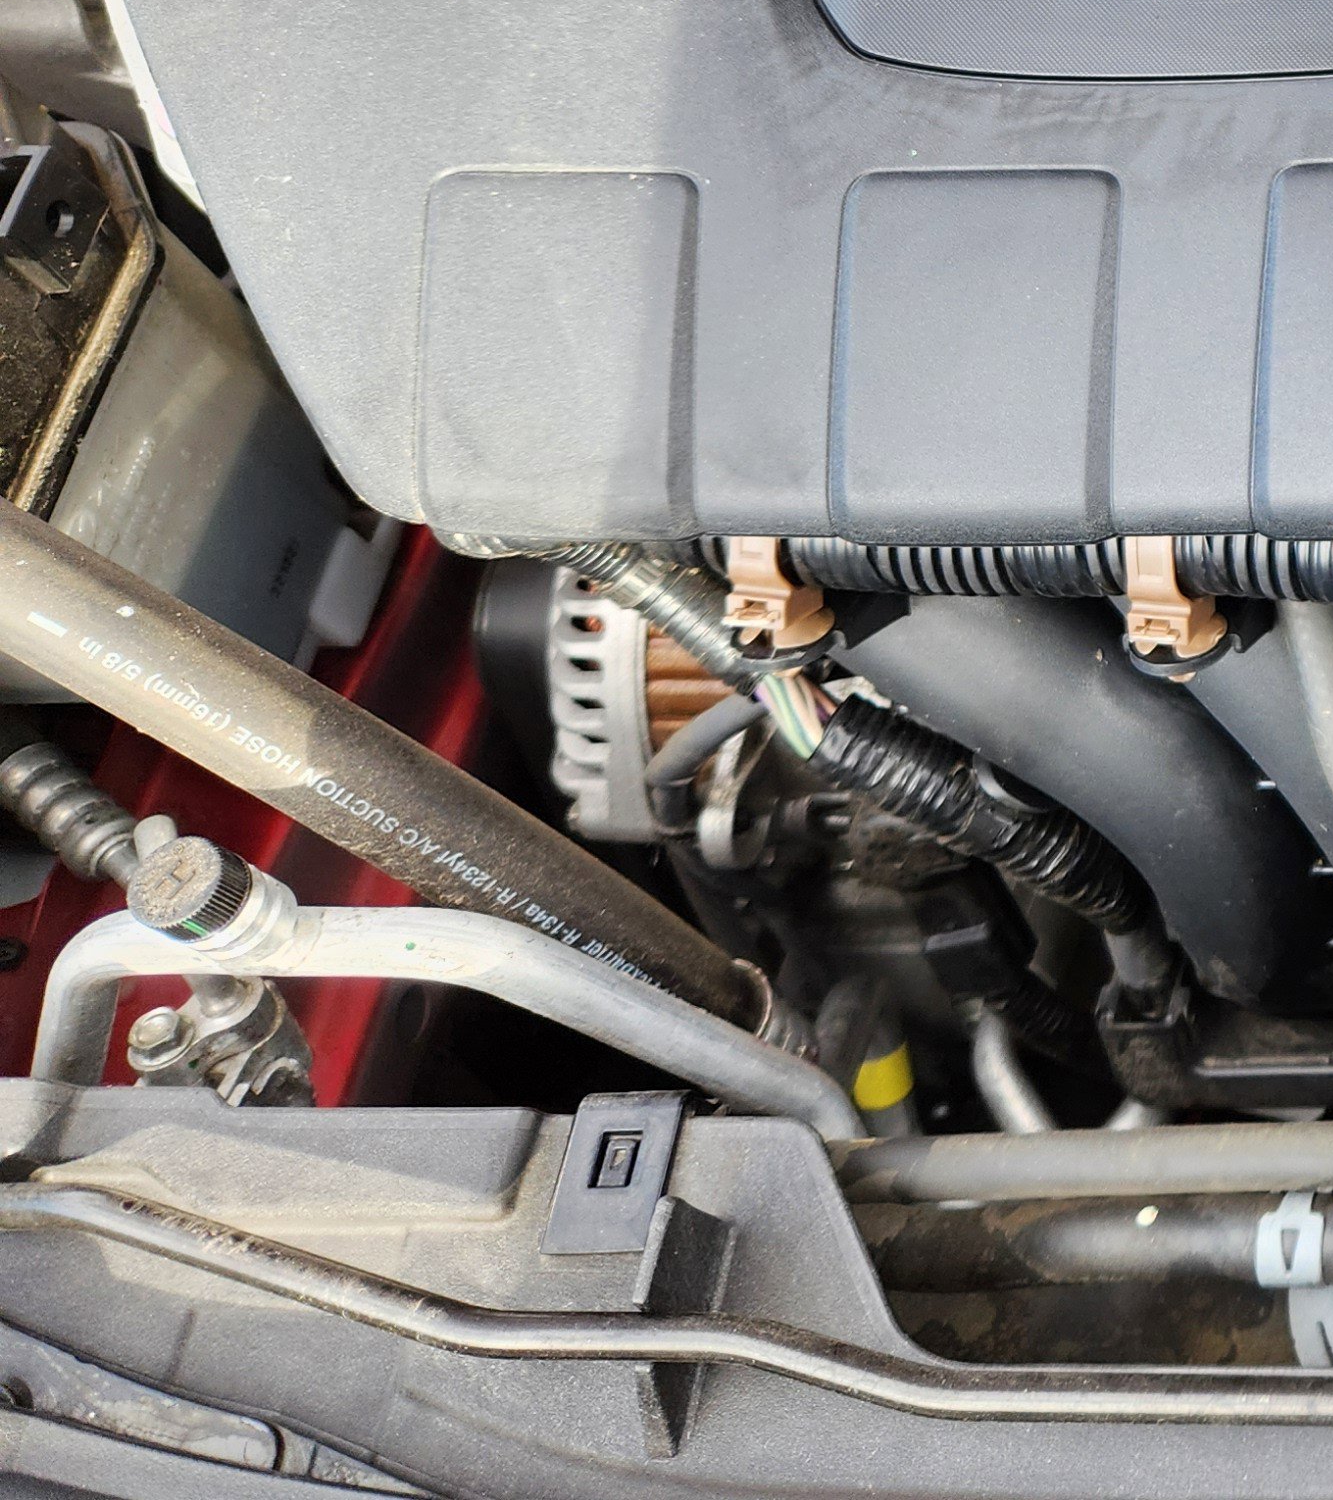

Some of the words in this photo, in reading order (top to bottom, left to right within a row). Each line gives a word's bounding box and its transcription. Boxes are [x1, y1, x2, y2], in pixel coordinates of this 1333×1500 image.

[79, 636, 103, 660] in
[101, 651, 142, 682] 5/8
[143, 672, 232, 733] (16mm)
[228, 725, 301, 775] HOSE
[299, 766, 400, 834] SUCTION
[399, 828, 441, 856] A/C
[433, 850, 518, 907] R-1234yf
[524, 903, 582, 946] R-134a
